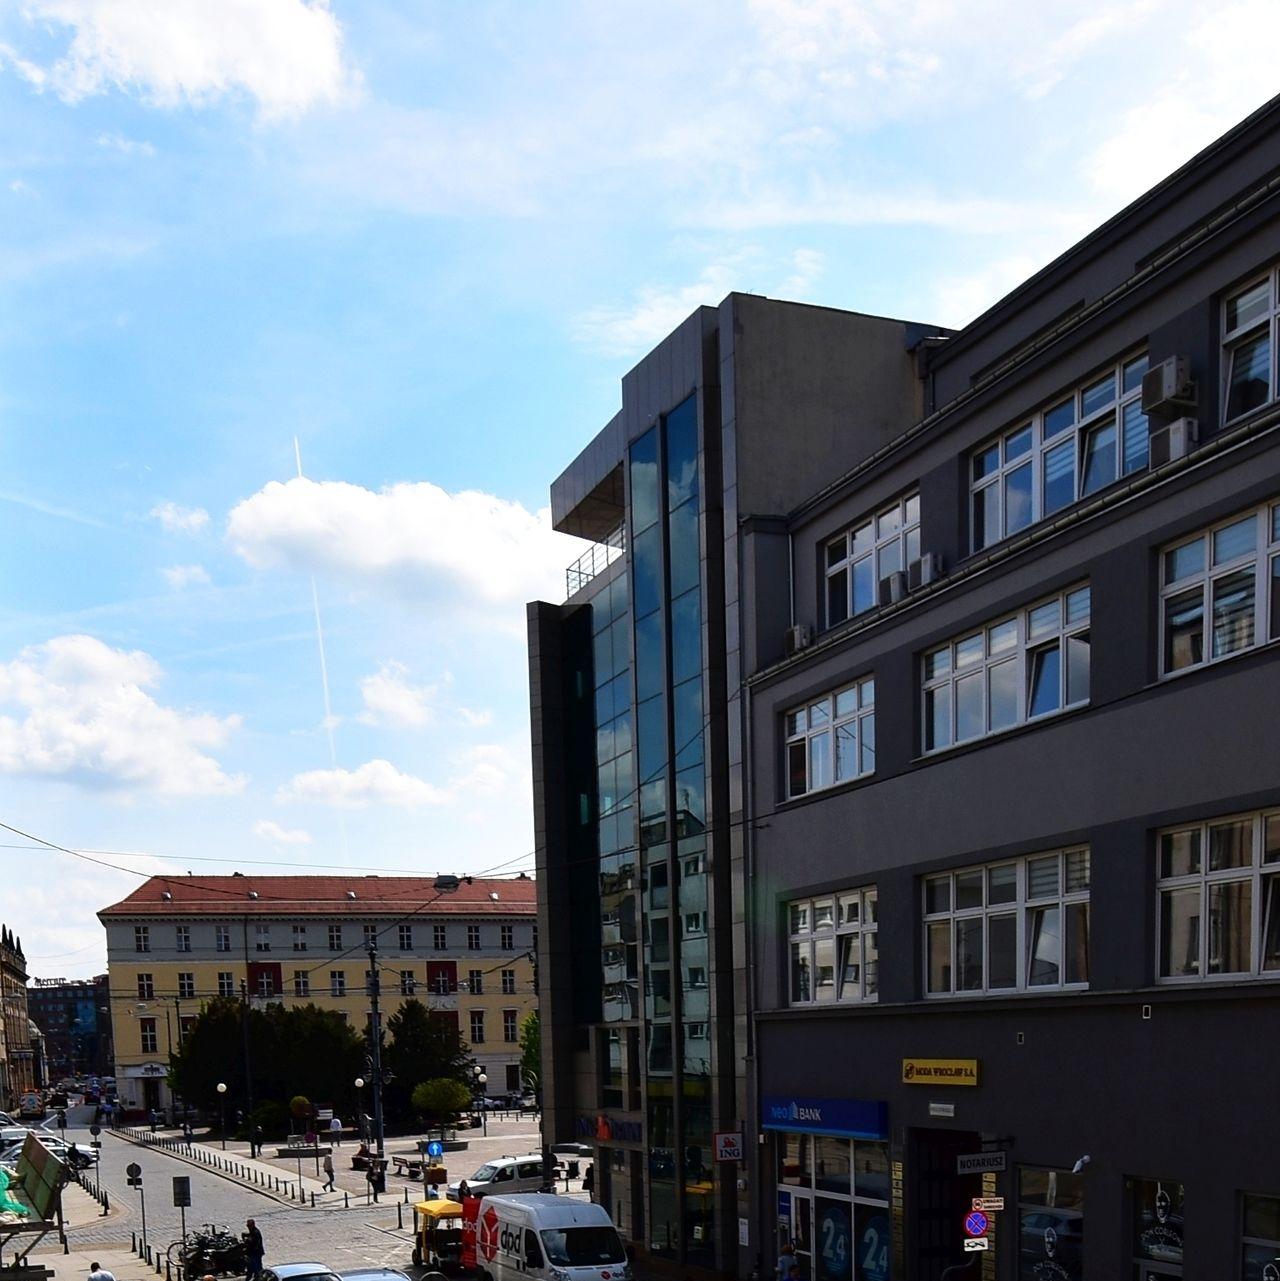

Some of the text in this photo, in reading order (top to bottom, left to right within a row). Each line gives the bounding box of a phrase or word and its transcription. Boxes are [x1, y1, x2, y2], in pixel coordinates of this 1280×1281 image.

[799, 1107, 822, 1121] BANK
[719, 1148, 740, 1158] ING
[960, 1156, 1003, 1169] NOTARIUSZ
[501, 1223, 522, 1256] dpd
